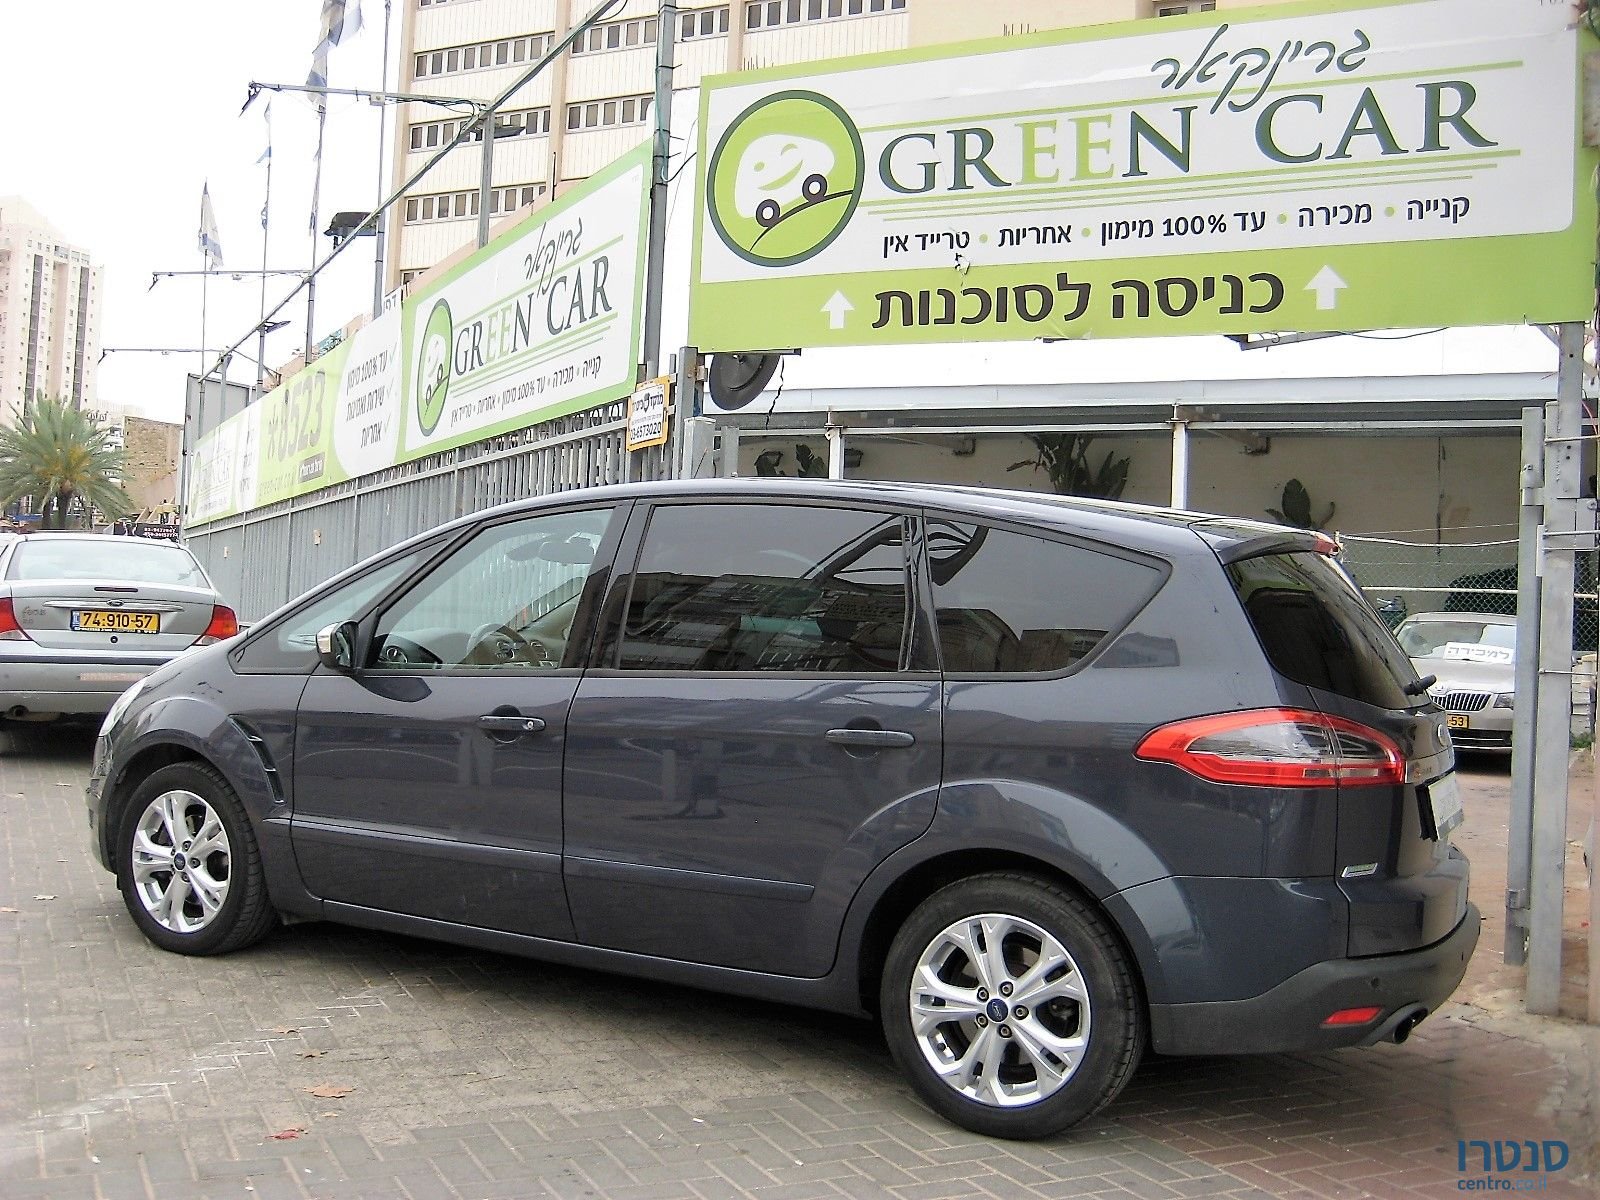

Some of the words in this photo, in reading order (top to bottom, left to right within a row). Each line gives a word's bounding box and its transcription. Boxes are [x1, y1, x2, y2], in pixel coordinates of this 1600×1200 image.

[1151, 23, 1371, 115] גרינקאר
[878, 105, 1198, 194] GREEN
[1254, 80, 1499, 164] CAR
[1234, 210, 1266, 233] עד
[1298, 202, 1372, 227] מכירה
[1407, 196, 1470, 224] קנייה
[998, 224, 1072, 247] אחריות
[1100, 218, 1154, 247] מימון
[1162, 213, 1227, 237] 100%
[883, 234, 908, 259] אין
[914, 230, 970, 251] טרייד
[524, 217, 583, 299] גרינקאר
[871, 272, 1092, 329] לסוכנות
[1111, 272, 1285, 318] כניסה
[455, 292, 535, 376] GREEN
[546, 255, 613, 336] CAR
[360, 357, 377, 383] 100%
[379, 349, 388, 372] עד
[582, 355, 602, 381] קנייה
[536, 375, 546, 395] עד
[552, 366, 574, 388] מכירה
[501, 387, 517, 411] מימון
[517, 380, 535, 400] 100%
[360, 420, 382, 449] אחריות
[83, 612, 153, 629] 74-910-57
[1447, 645, 1511, 660] למכירה
[1447, 716, 1464, 726] -53
